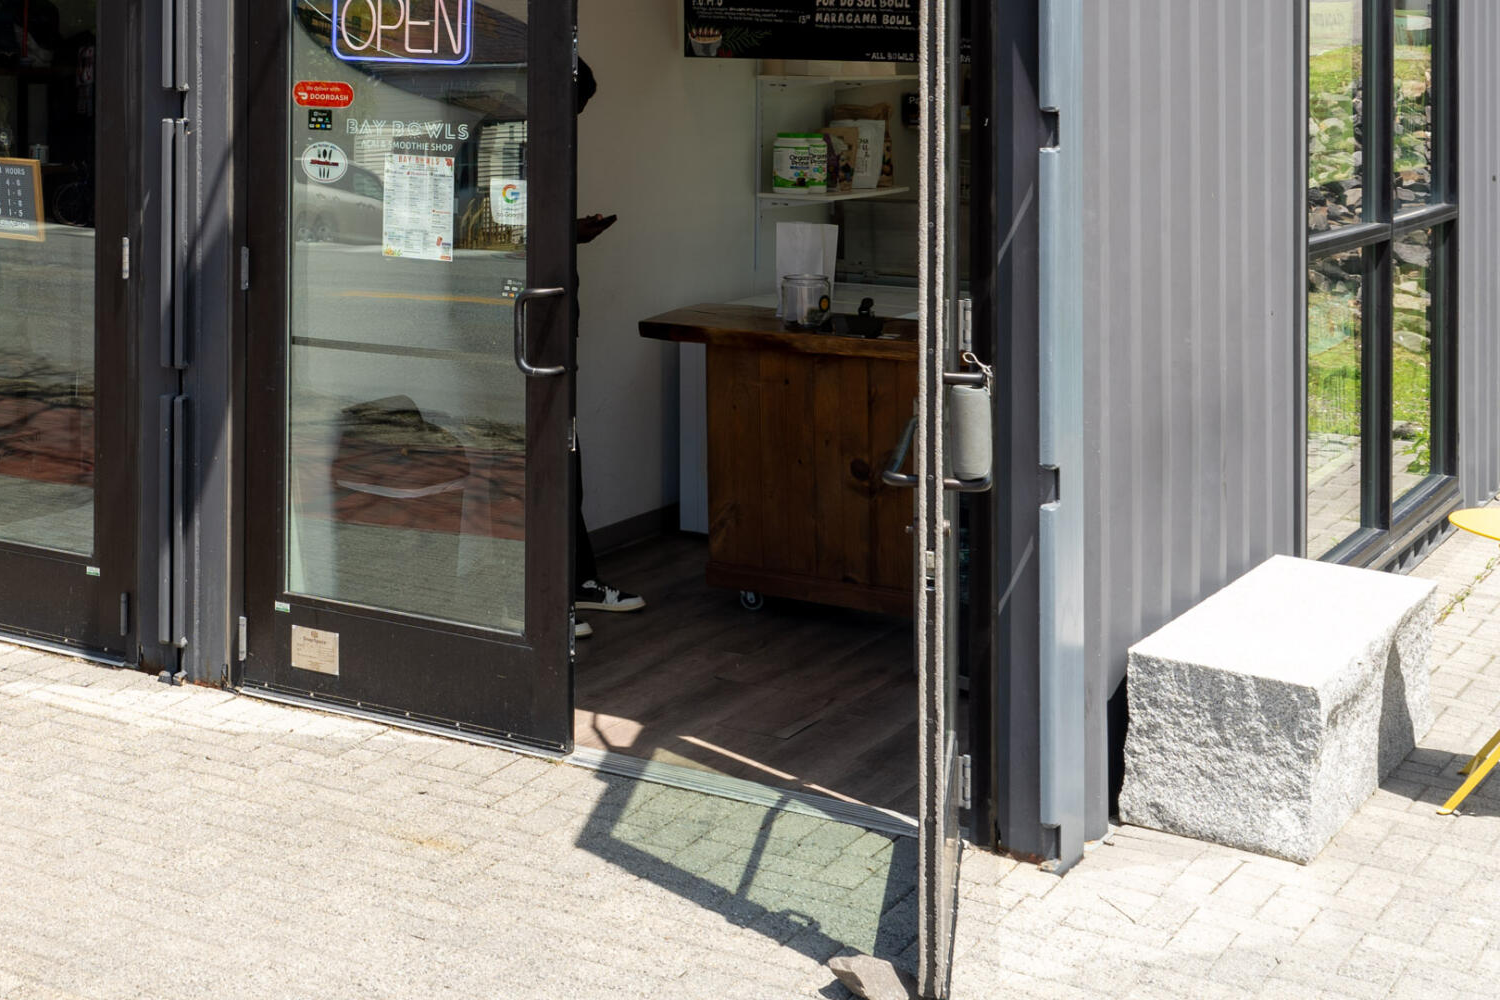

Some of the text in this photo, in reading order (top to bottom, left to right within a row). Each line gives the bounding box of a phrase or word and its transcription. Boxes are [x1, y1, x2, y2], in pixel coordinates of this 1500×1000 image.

[882, 14, 912, 26] BOWL
[310, 93, 349, 102] DOORDASH
[346, 118, 387, 136] BAY
[392, 120, 470, 141] BOWLS
[431, 142, 454, 152] SHOP
[5, 167, 26, 176] HOURS
